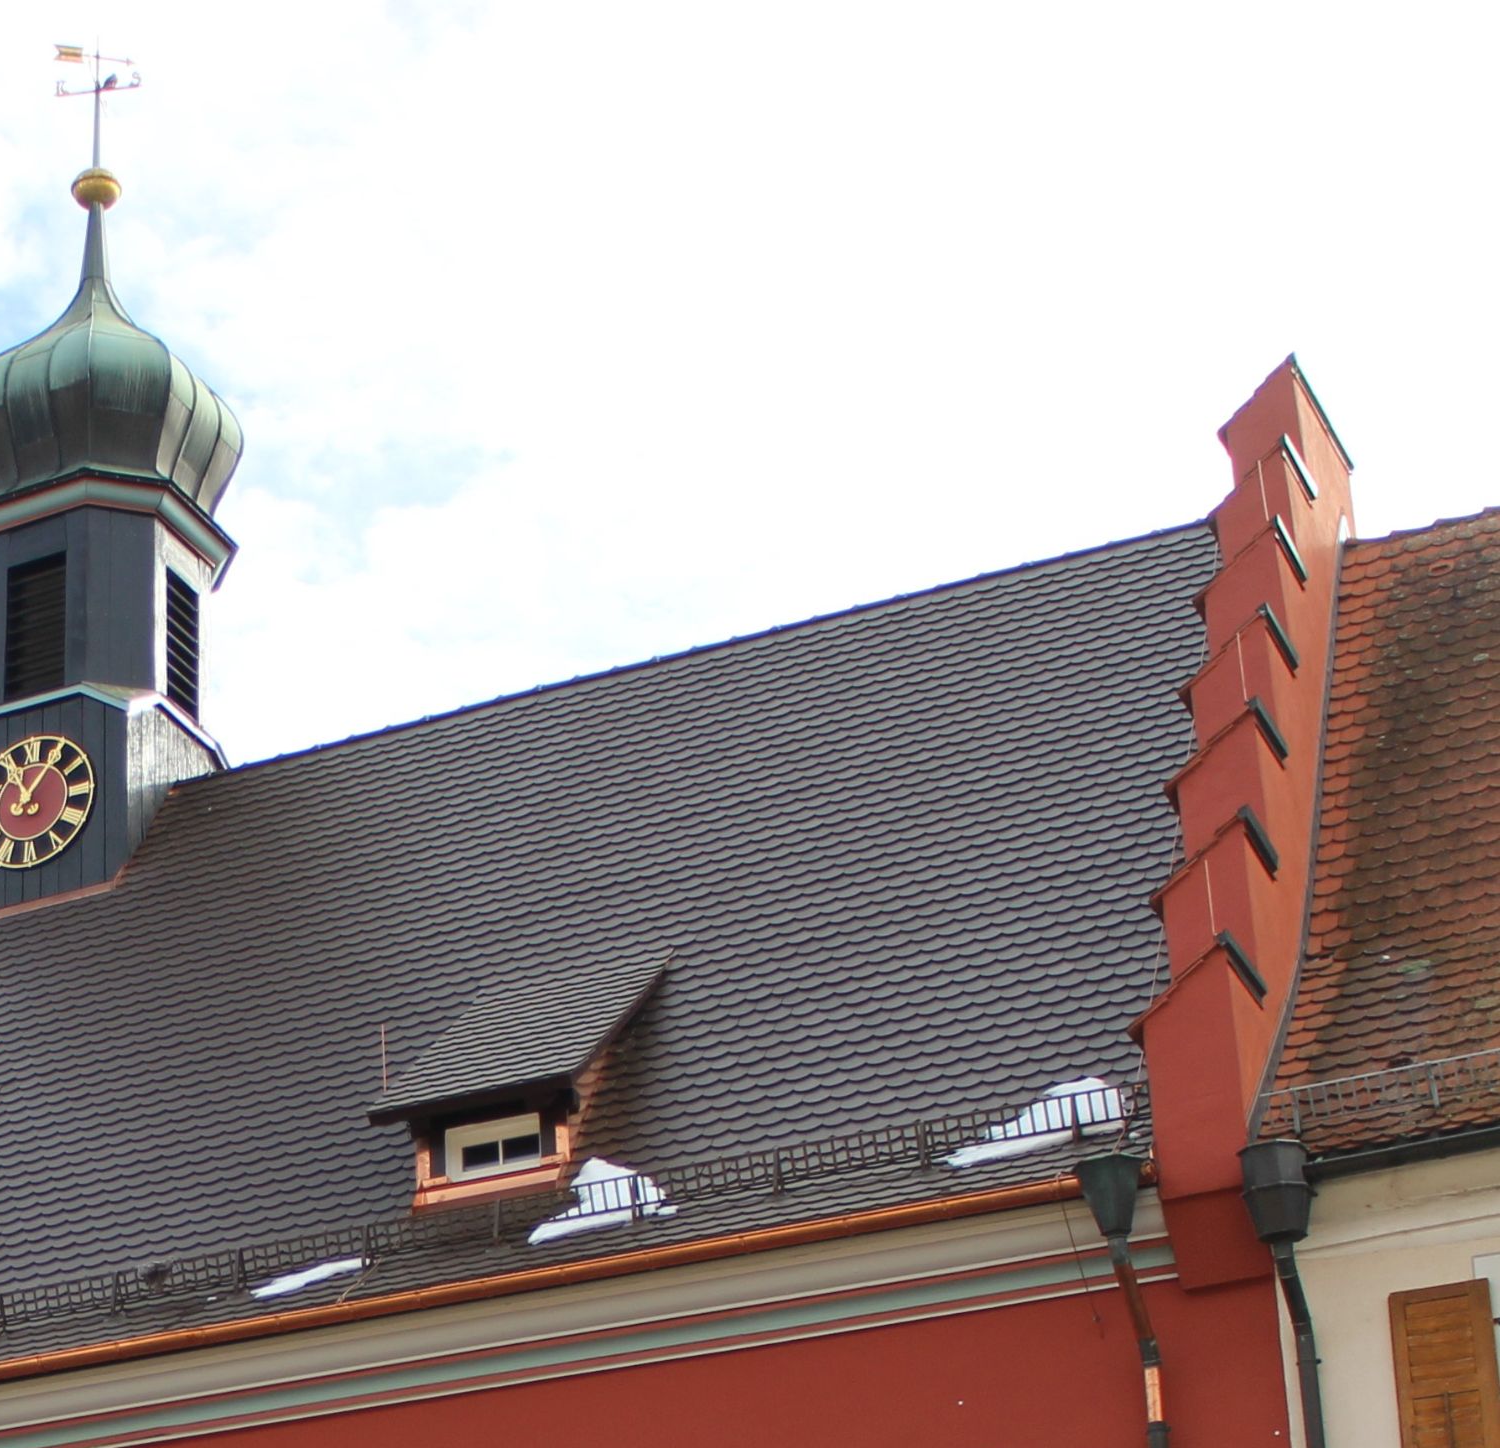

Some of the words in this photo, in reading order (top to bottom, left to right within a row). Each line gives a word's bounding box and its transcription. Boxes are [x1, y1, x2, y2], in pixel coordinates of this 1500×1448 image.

[23, 741, 40, 765] XII
[49, 830, 64, 850] V
[23, 841, 37, 863] VI
